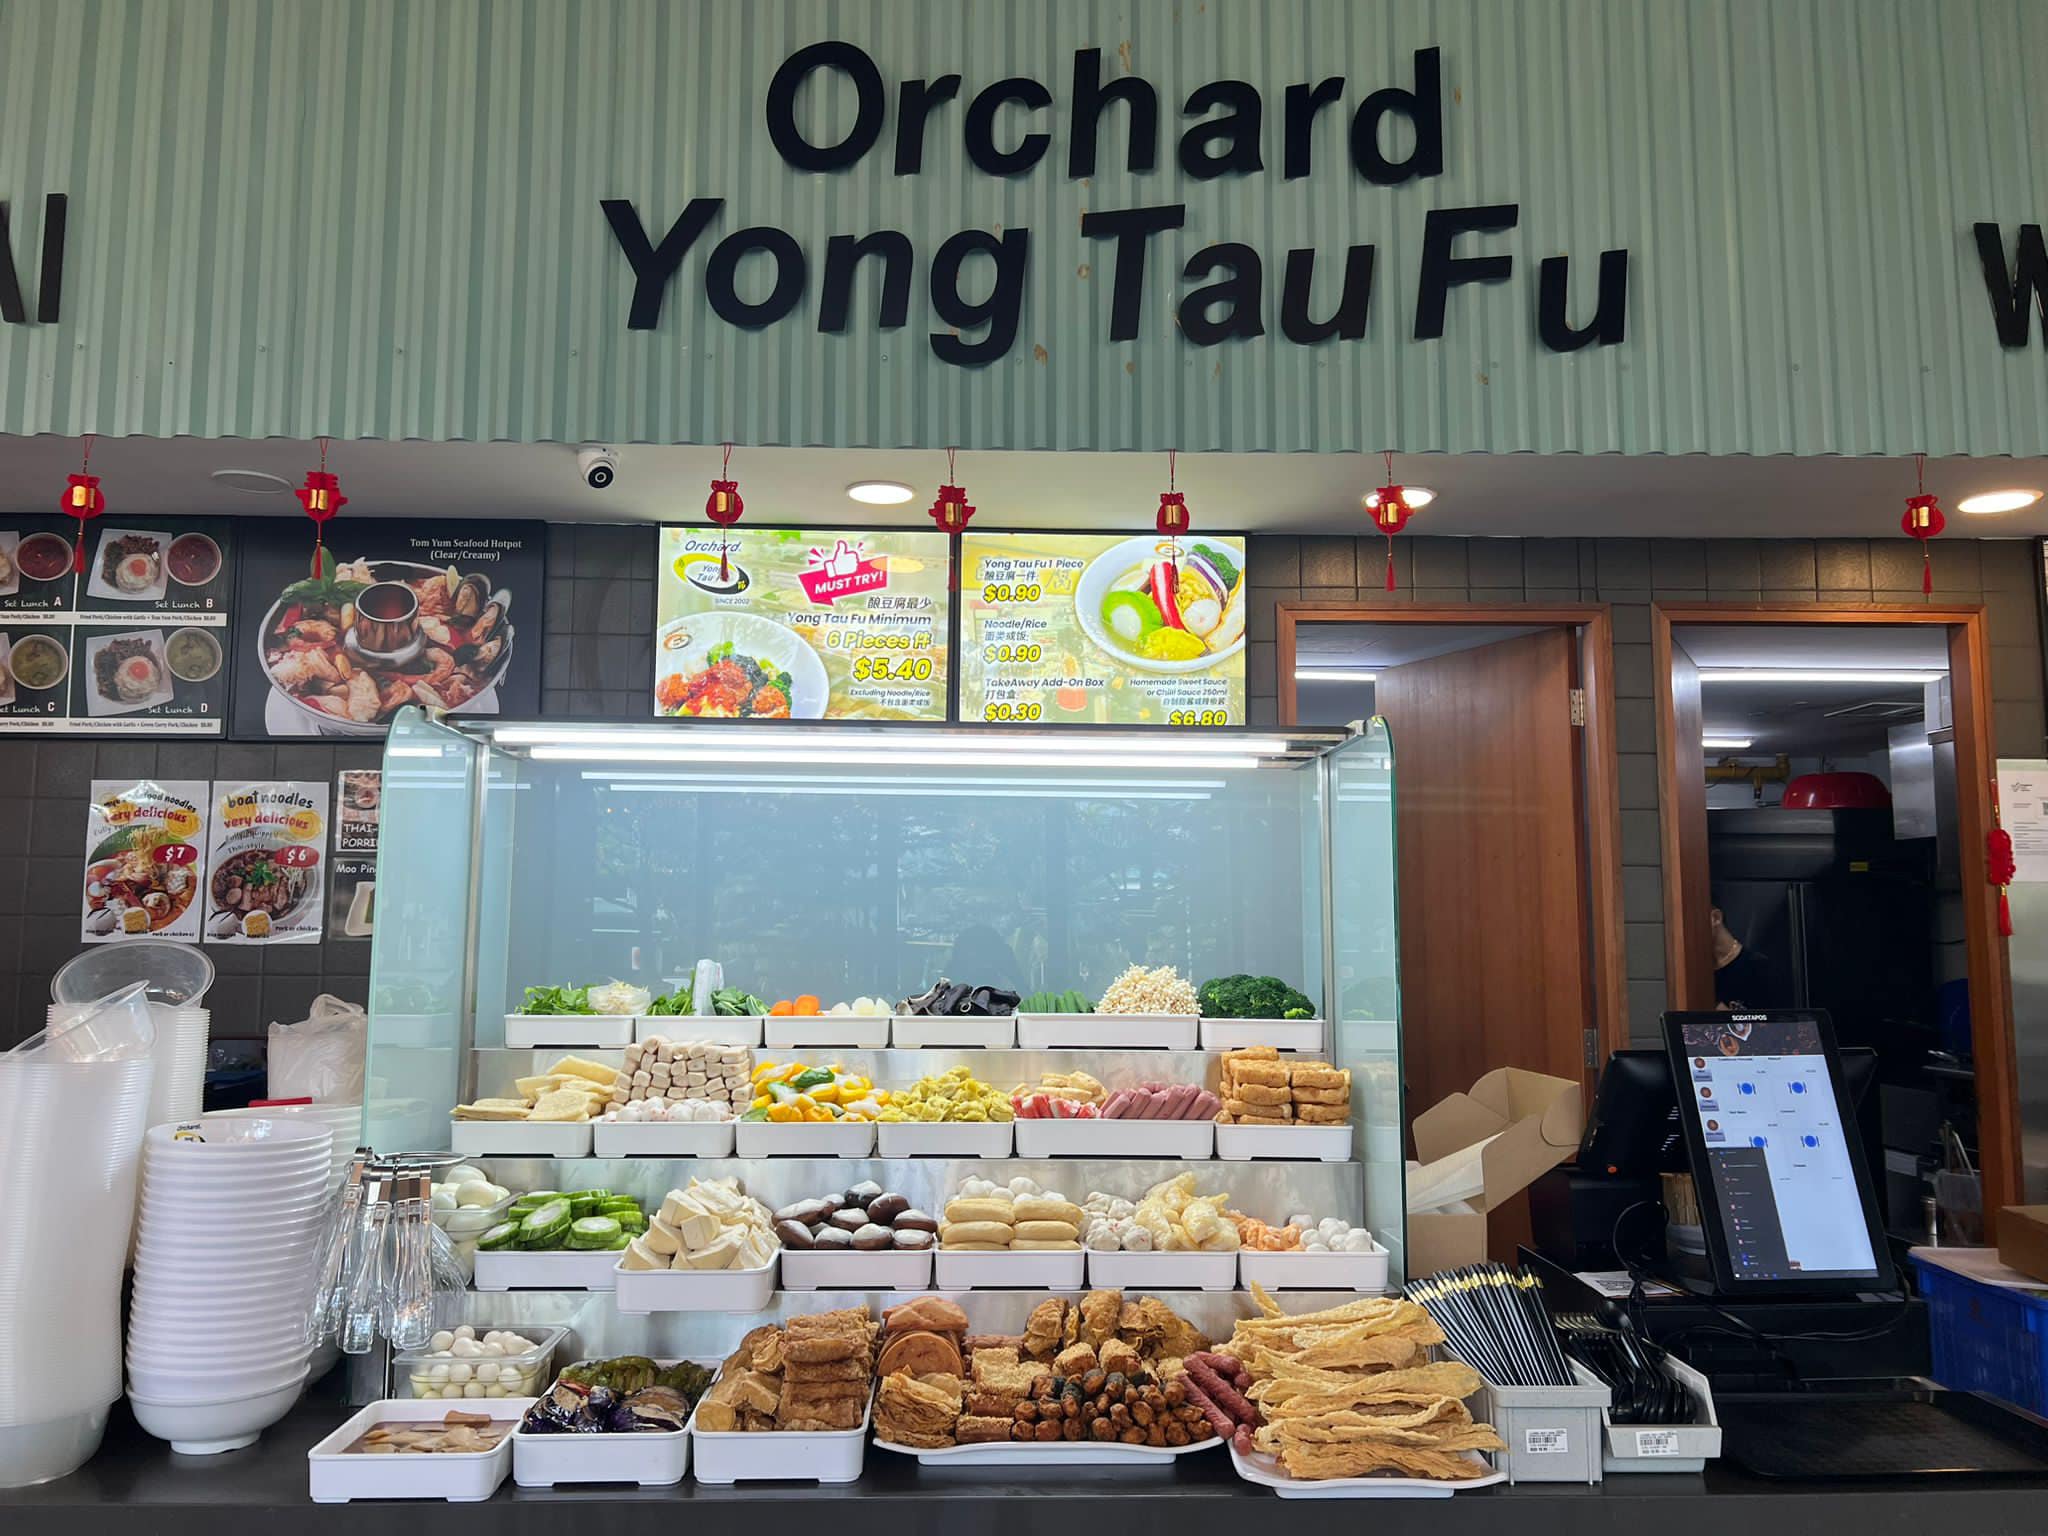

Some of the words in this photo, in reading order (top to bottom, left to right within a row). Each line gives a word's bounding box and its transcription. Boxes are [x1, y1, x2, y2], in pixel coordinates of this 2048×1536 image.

[766, 41, 1443, 185] Orchard
[599, 198, 1028, 367] Yong
[1082, 204, 1375, 346] Tau
[1414, 204, 1628, 353] Fu
[411, 538, 429, 547] Tom
[432, 538, 451, 547] Yum
[453, 538, 488, 548] Seafood
[491, 539, 521, 550] Hotpot
[685, 540, 740, 552] Orchard
[430, 550, 500, 561] (Clear/Creamy)
[985, 559, 1011, 570] Yong
[1014, 560, 1032, 569] Tau
[1035, 560, 1047, 569] Fu
[1056, 559, 1083, 569] Piece
[815, 579, 851, 595] MUST
[853, 571, 883, 590] TRY!
[984, 583, 1041, 602] $0.90
[4, 599, 18, 608] Set
[21, 599, 48, 608] Lunch
[54, 597, 62, 607] A
[155, 600, 168, 609] Set
[172, 600, 200, 609] Lunch
[206, 598, 213, 608] B
[868, 597, 932, 610] 酿豆腐最少
[788, 612, 821, 625] Yong
[825, 613, 849, 624] Tau
[851, 613, 866, 624] Fu
[868, 612, 932, 625] Minimum
[985, 618, 1048, 630] Noodle/Rice
[827, 631, 840, 648] 6
[844, 630, 910, 649] Pieces
[984, 644, 1041, 664] $0.90
[853, 657, 932, 681] $5.40
[985, 678, 1040, 688] TakeAway
[1041, 678, 1083, 687] Add-On
[1085, 678, 1104, 687] Box
[850, 689, 886, 698] Excluding
[887, 689, 930, 698] Noodle/Rice
[0, 704, 13, 713] et
[14, 704, 40, 713] Lunch
[47, 702, 55, 712] C
[165, 705, 193, 714] Lunch
[200, 702, 208, 713] D
[984, 703, 1041, 722] $0.30
[1169, 709, 1228, 726] $6.80
[164, 794, 197, 813] noodles
[227, 790, 259, 808] boat
[261, 792, 314, 809] noodles
[134, 806, 187, 823] delicious
[224, 816, 251, 829] very
[254, 812, 309, 829] delicious
[336, 864, 356, 873] Moo
[360, 864, 376, 874] Pin
